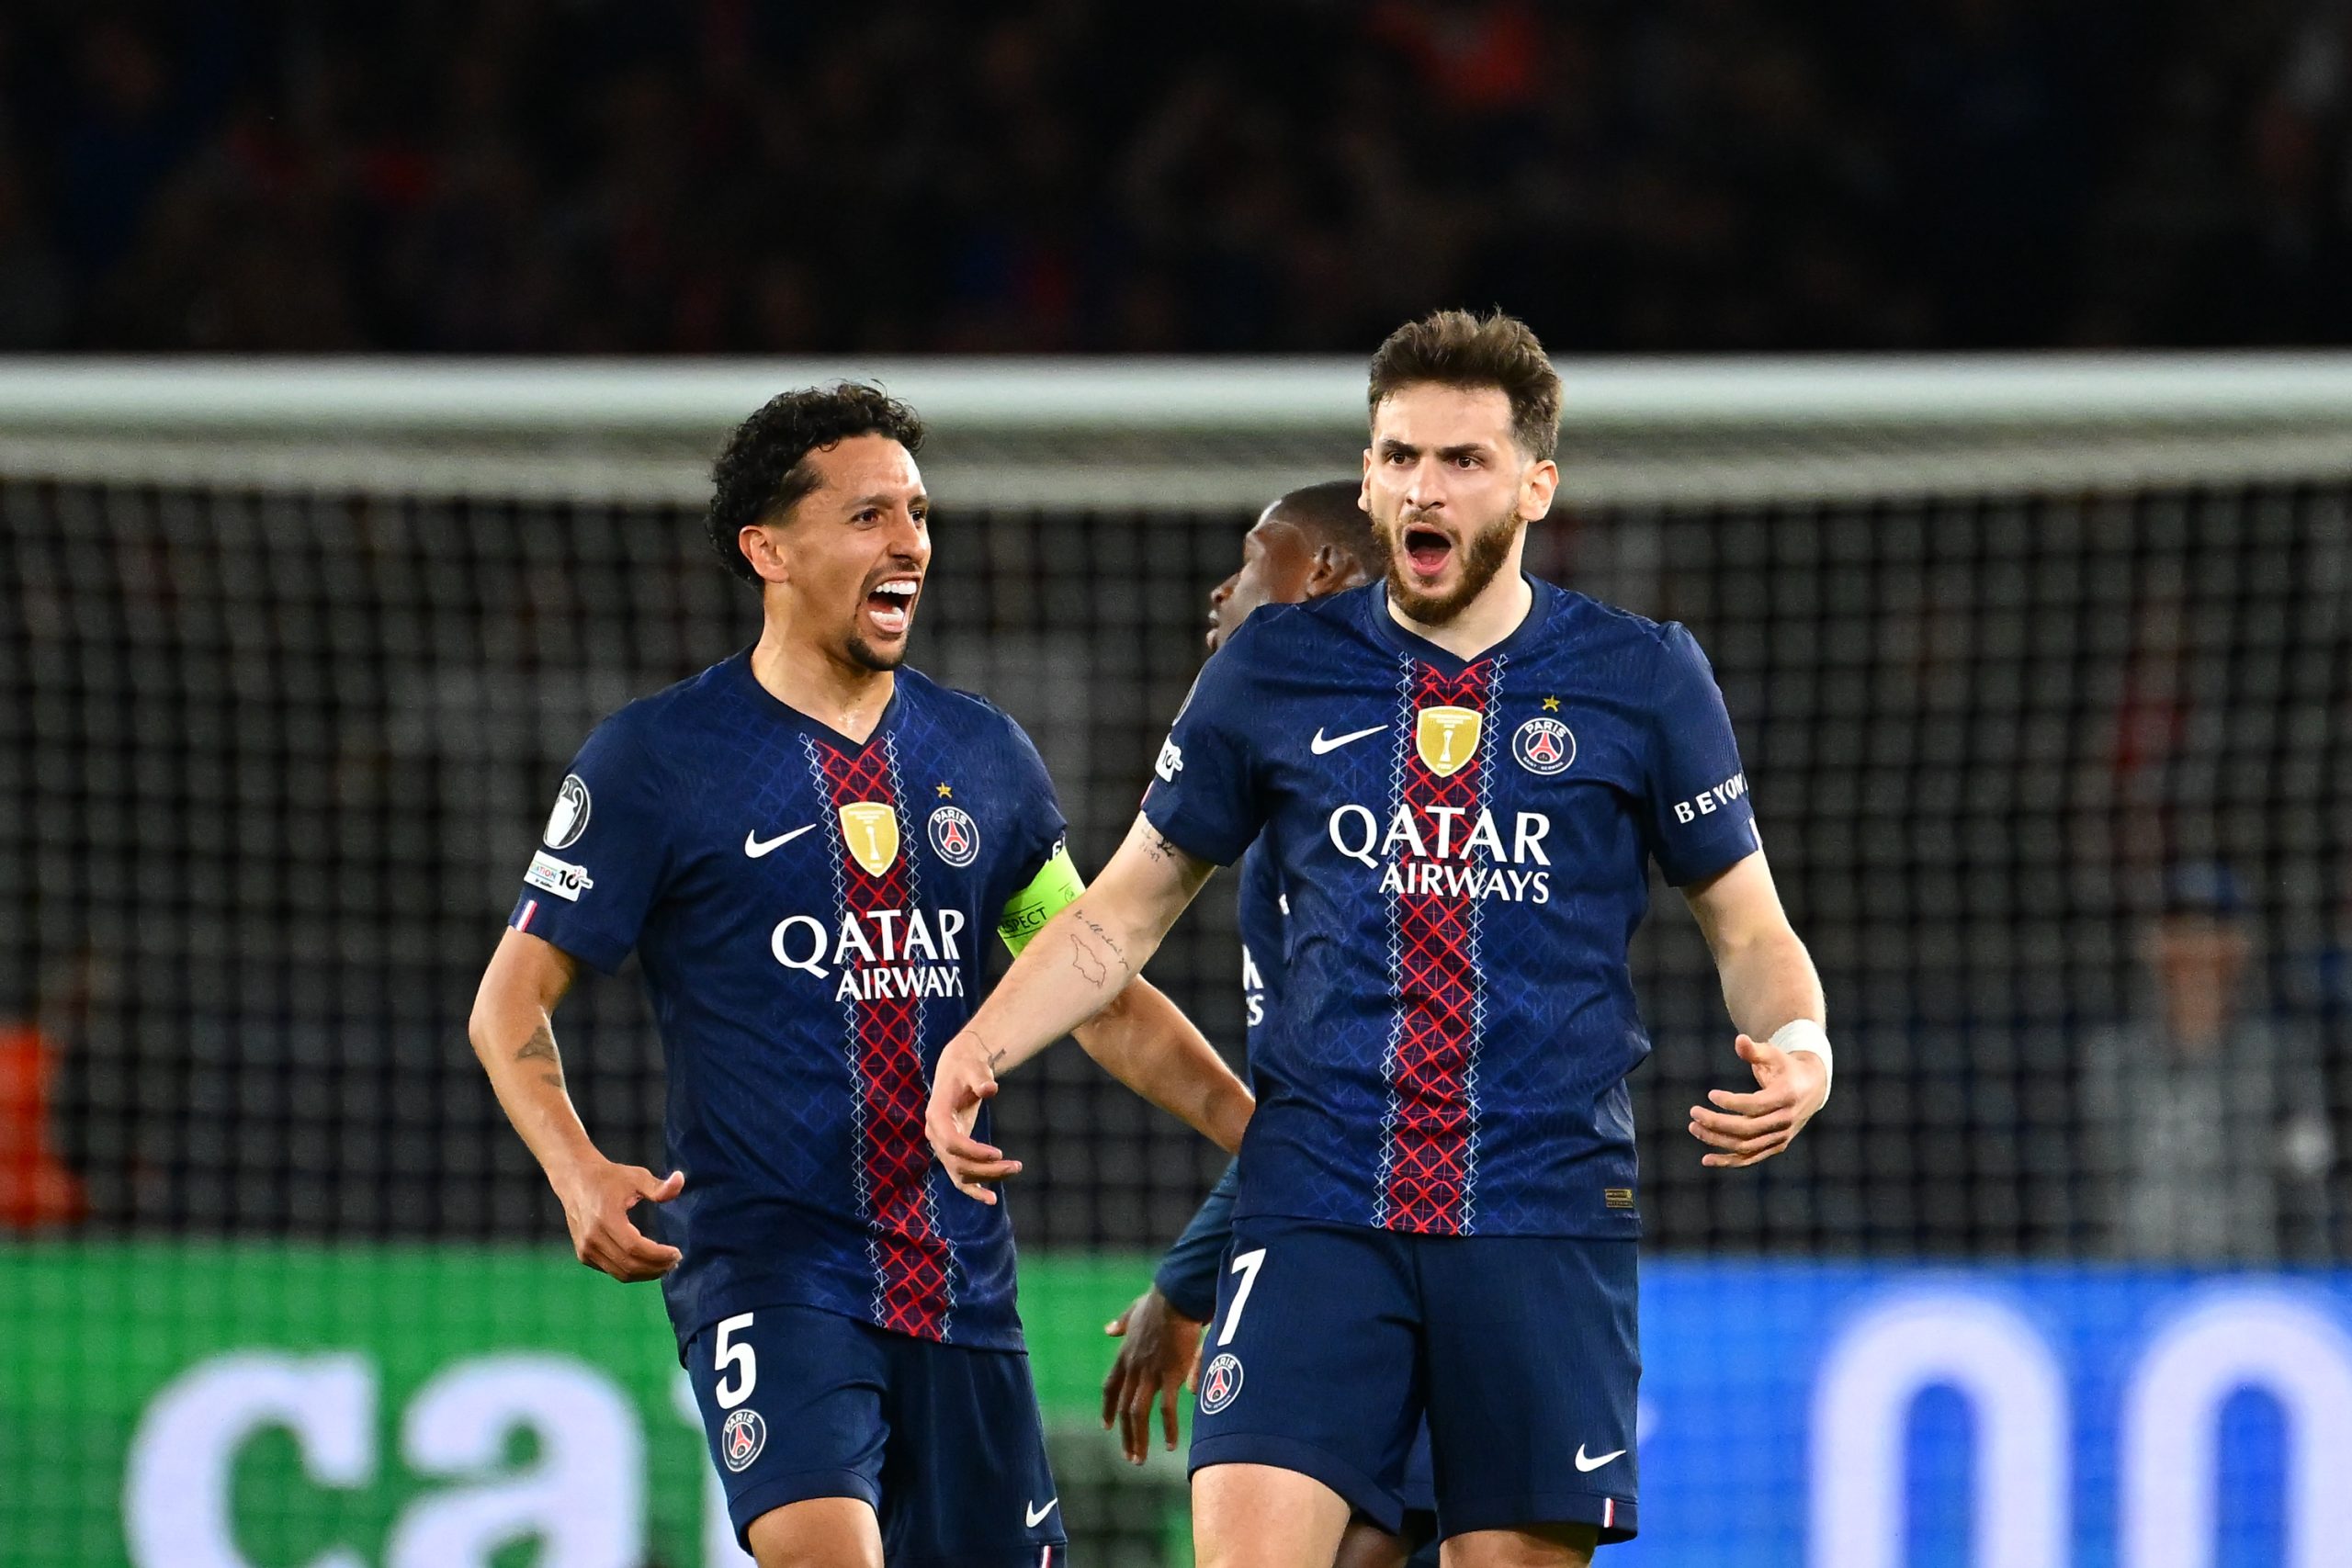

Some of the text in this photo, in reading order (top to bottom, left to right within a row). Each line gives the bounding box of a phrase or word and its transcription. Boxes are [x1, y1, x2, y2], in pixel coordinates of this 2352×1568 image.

[1524, 720, 1567, 739] PARIS
[933, 808, 968, 825] PARIS
[1673, 773, 1750, 824] BEYON
[1329, 803, 1552, 870] QATAR
[1378, 862, 1550, 905] AIRWAYS
[771, 908, 965, 980] QATAR
[835, 965, 964, 1002] AIRWAYS
[1216, 1247, 1267, 1347] 7
[714, 1312, 757, 1409] 5
[1209, 1357, 1237, 1375] PARIS
[725, 1412, 756, 1434] PARIS
